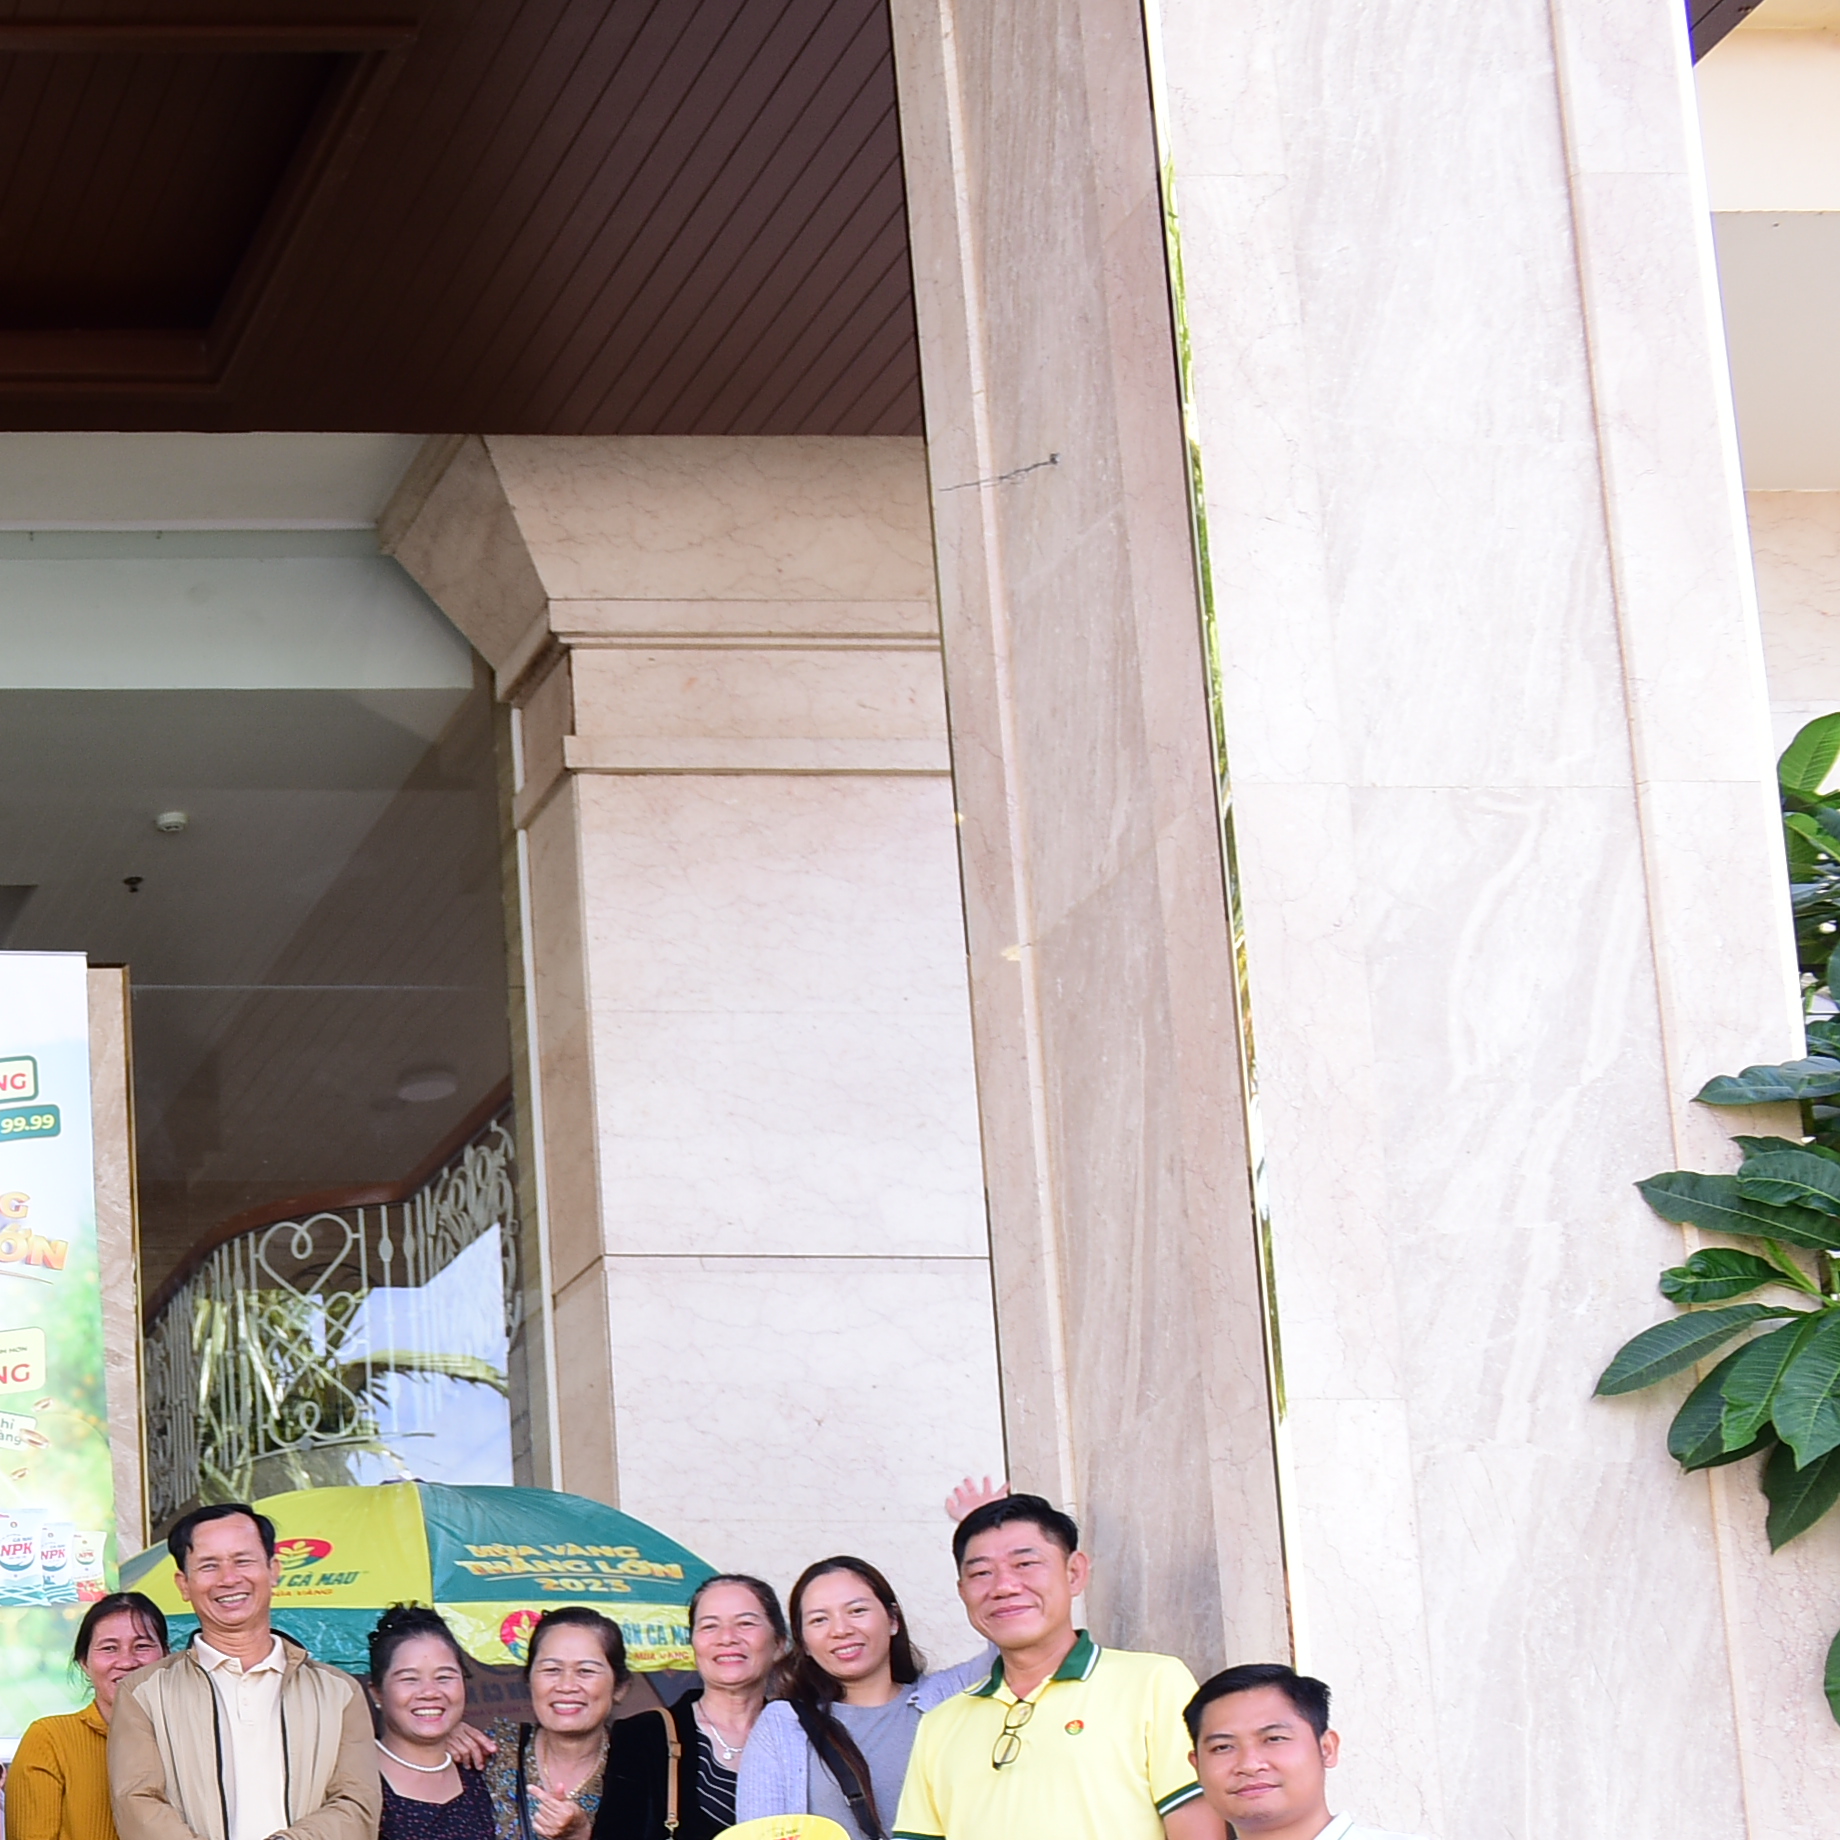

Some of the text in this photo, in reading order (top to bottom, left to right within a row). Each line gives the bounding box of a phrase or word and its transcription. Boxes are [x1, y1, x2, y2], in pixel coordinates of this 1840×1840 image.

[0, 1114, 55, 1133] 99.99
[0, 1543, 32, 1557] NPK
[464, 1543, 640, 1558] MÙA VÀNG
[454, 1557, 684, 1579] THẮNG LỚN
[316, 1571, 360, 1586] MAU
[535, 1578, 632, 1593] 2023
